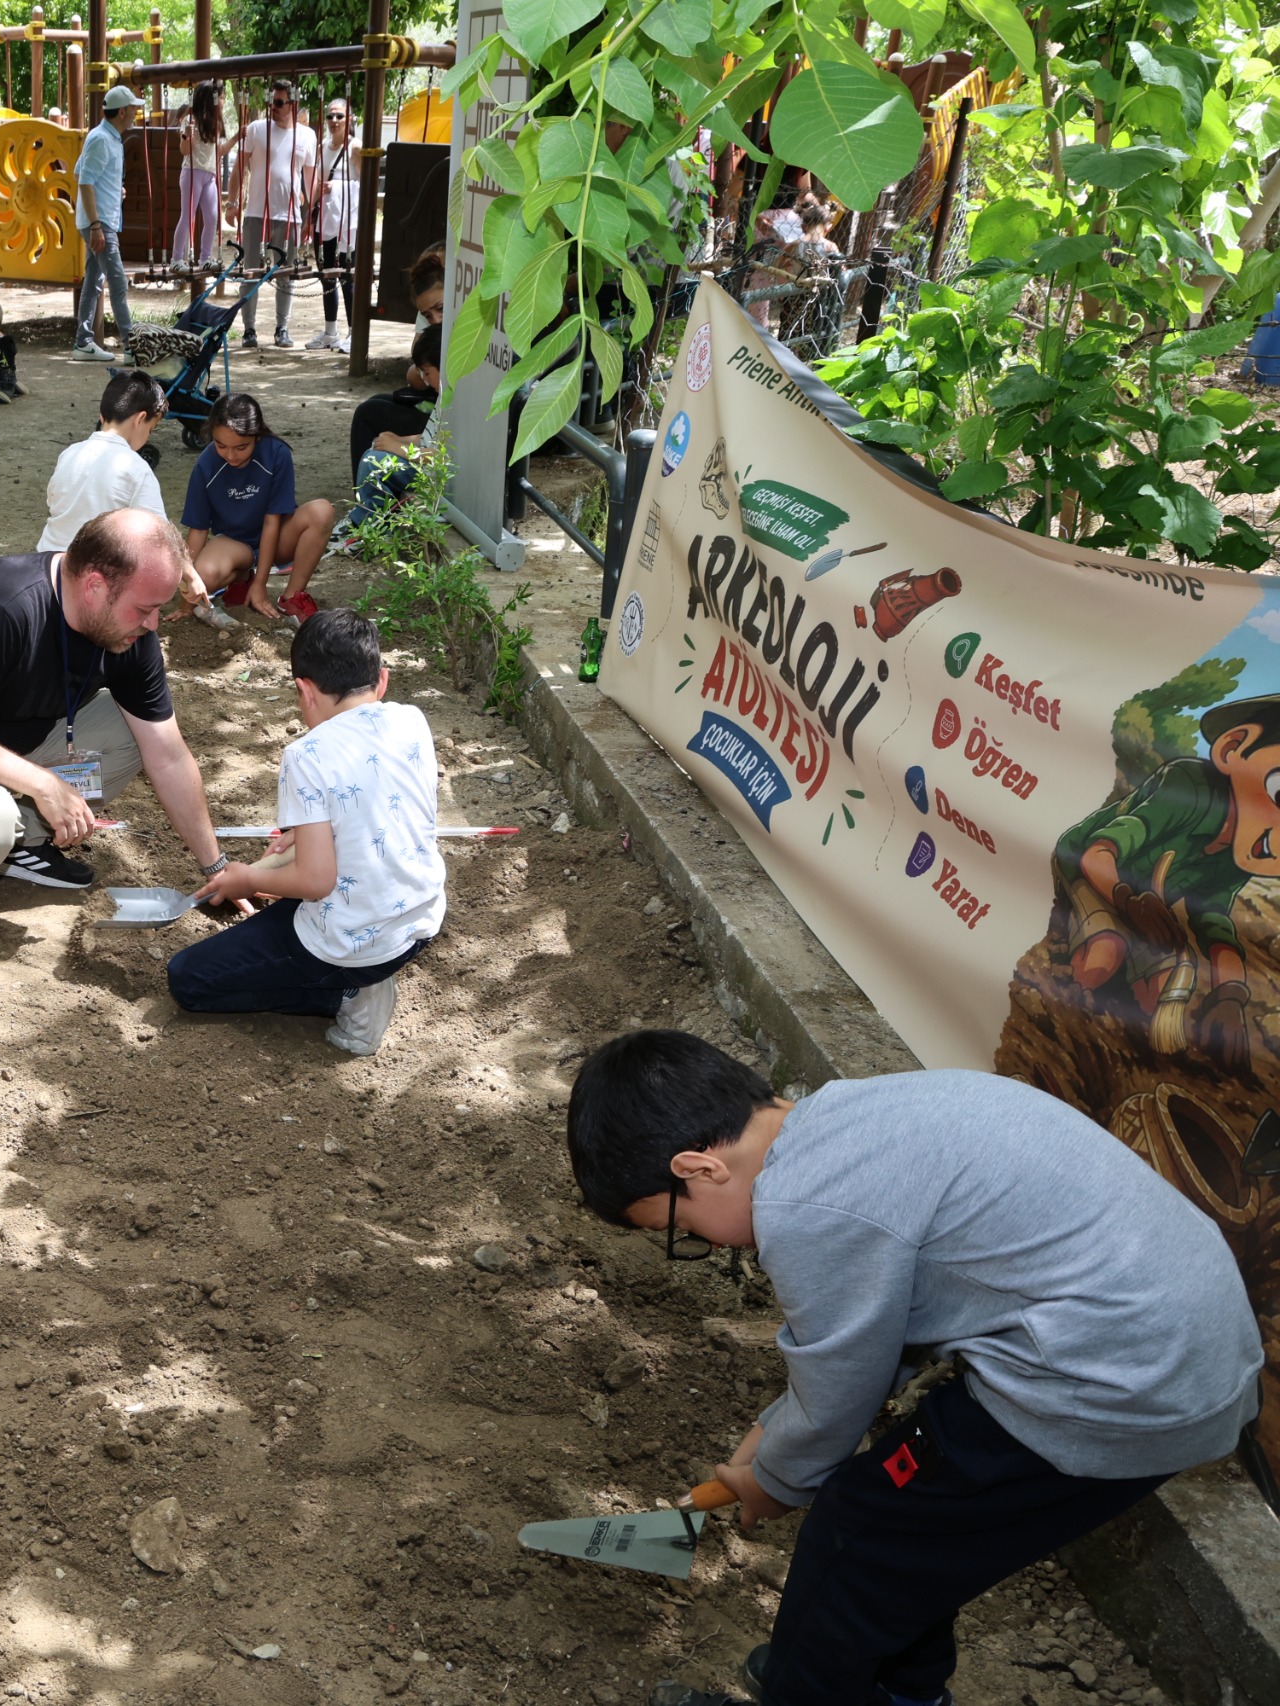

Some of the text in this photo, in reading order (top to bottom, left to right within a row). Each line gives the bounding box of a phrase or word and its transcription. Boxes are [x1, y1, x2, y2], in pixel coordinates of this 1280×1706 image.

[726, 345, 783, 390] Priene
[741, 507, 816, 550] ELECEĞİNE İLHAM OL!
[752, 488, 824, 528] GEÇMİŞİ KEŞFET,
[700, 635, 830, 801] ATÖLYESİ
[974, 652, 1062, 731] Keşfet
[700, 723, 777, 805] ÇOCUKLAR İÇİN
[963, 716, 1039, 800] Öğren
[935, 787, 997, 854] Dene
[931, 858, 992, 930] Yarat
[591, 1520, 610, 1546] EMKA
